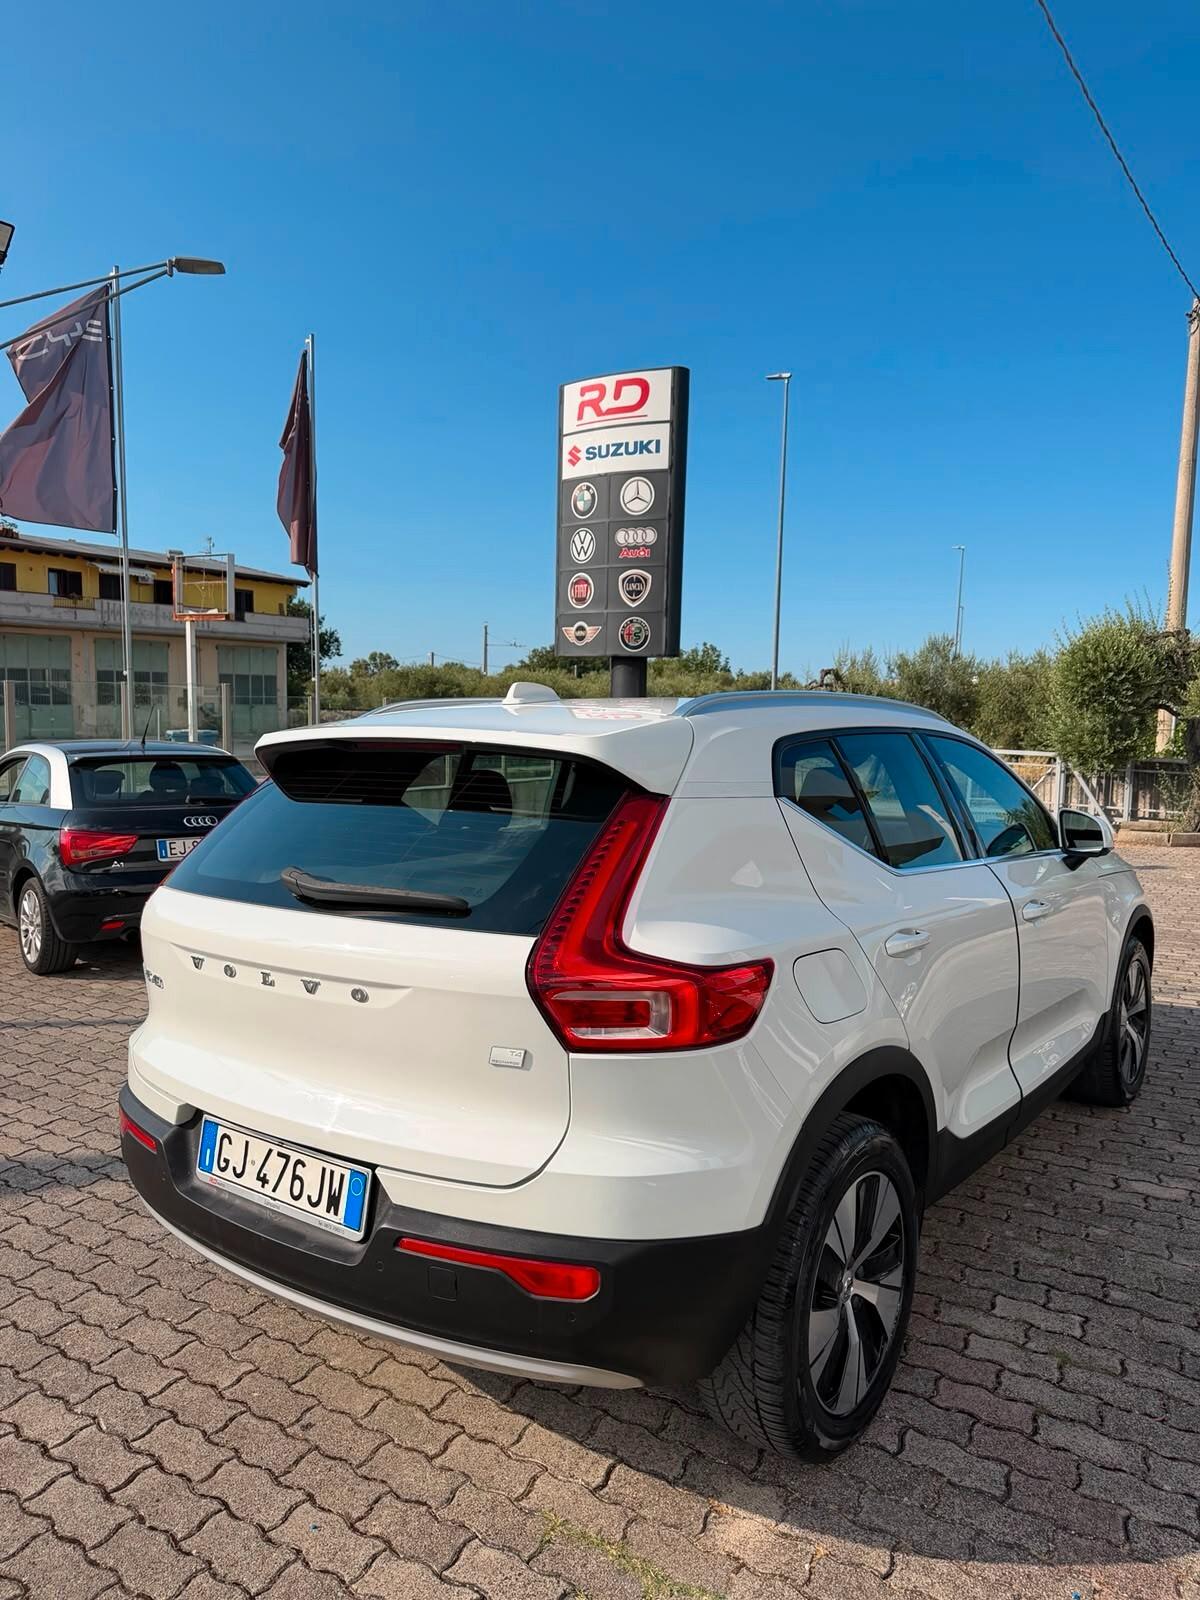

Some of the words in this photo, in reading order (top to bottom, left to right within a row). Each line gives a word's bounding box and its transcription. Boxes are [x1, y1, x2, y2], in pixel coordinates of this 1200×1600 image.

[577, 378, 650, 421] RD
[585, 439, 661, 461] SUZUKI
[191, 955, 369, 1003] VOLVO
